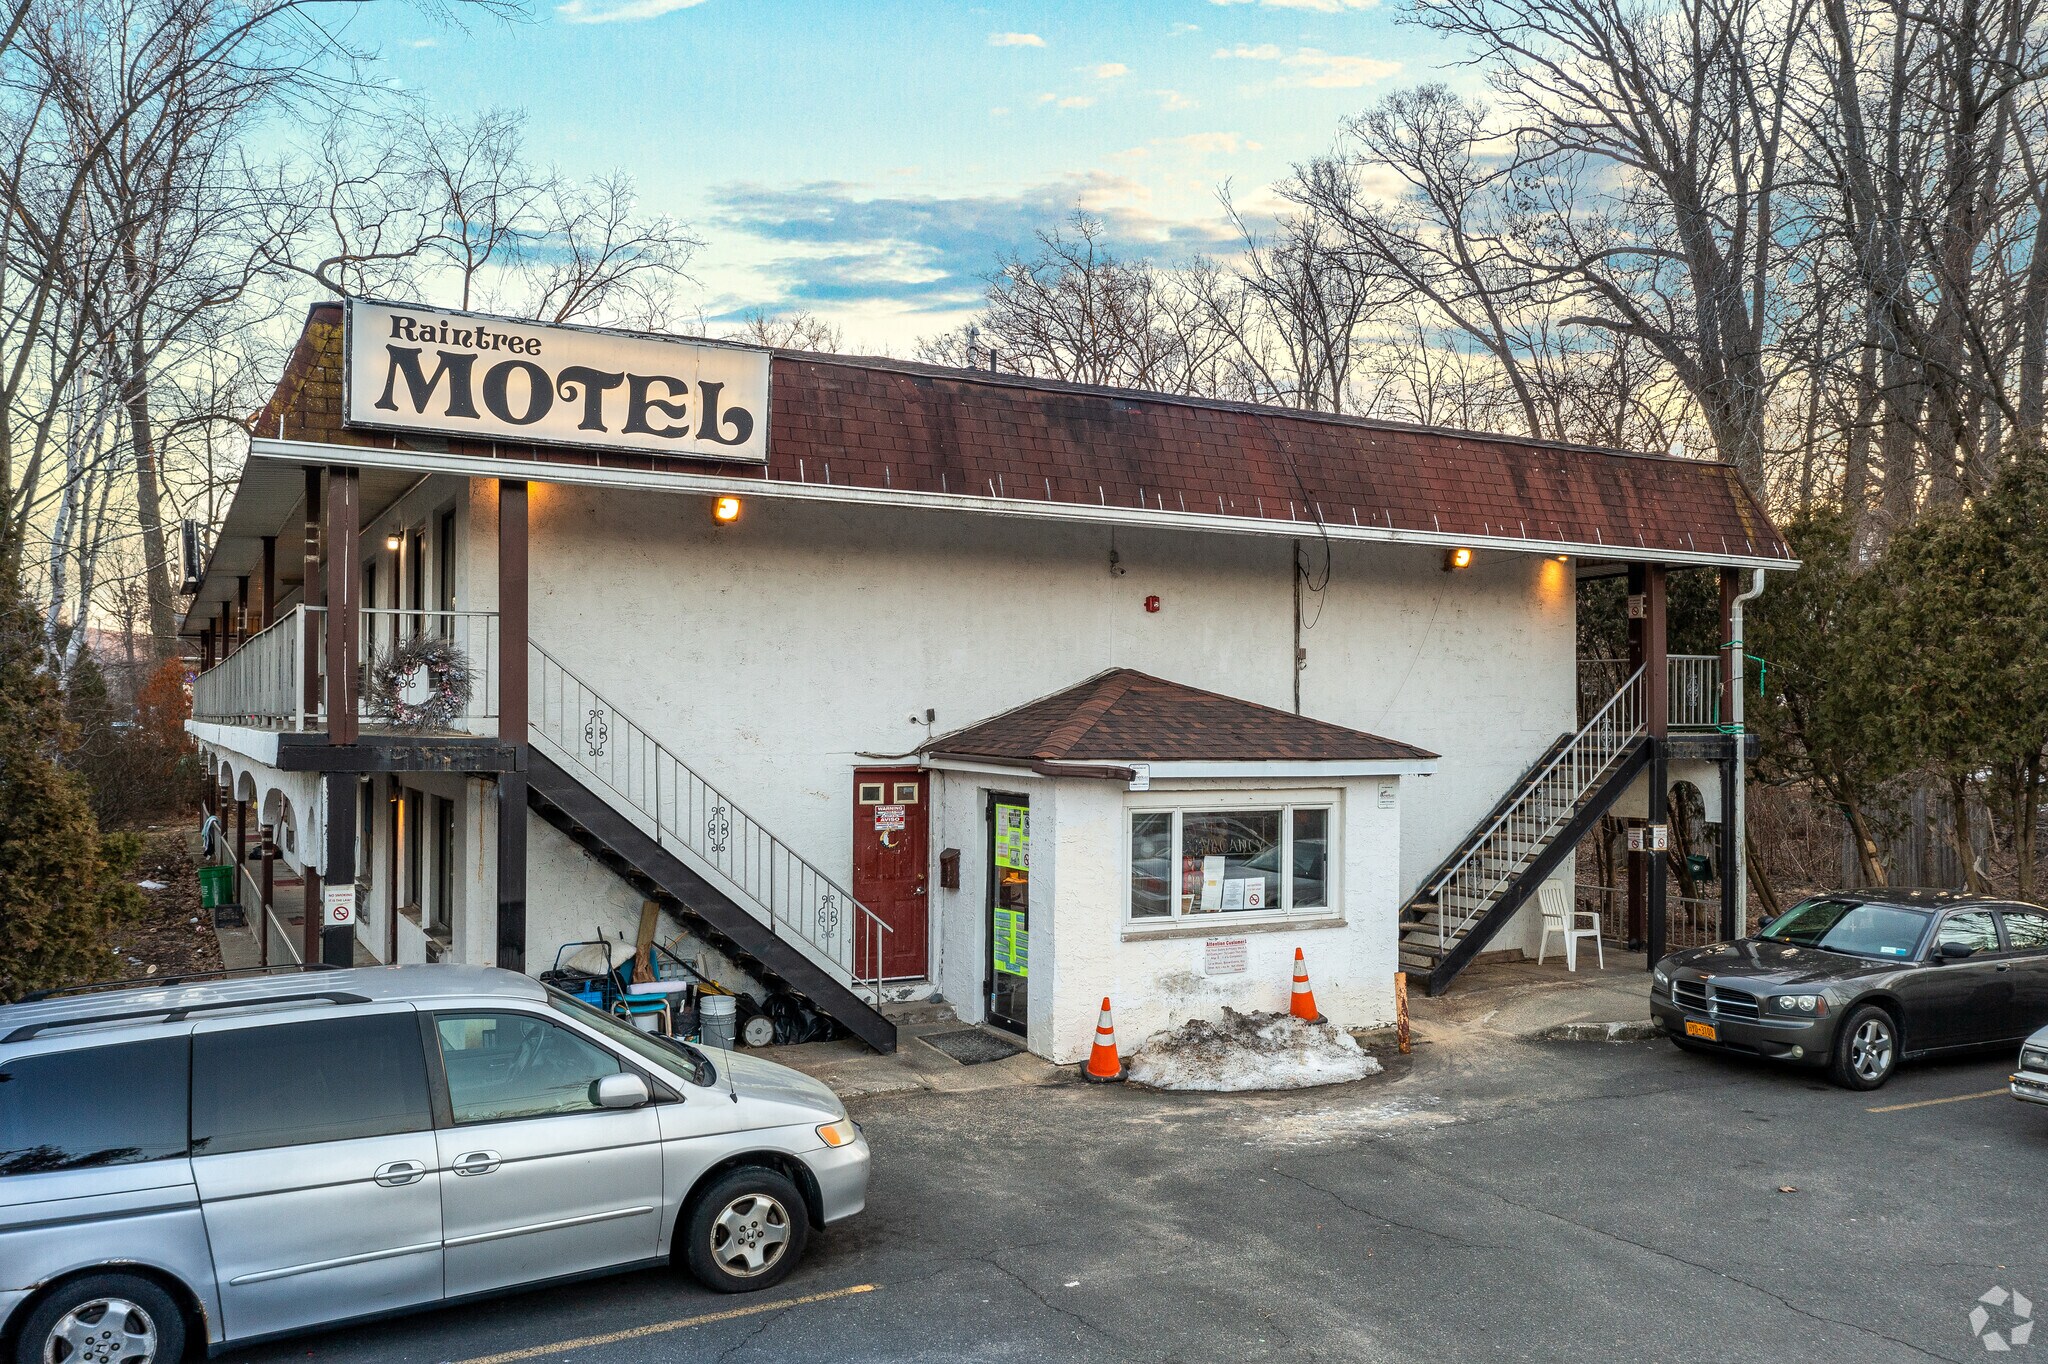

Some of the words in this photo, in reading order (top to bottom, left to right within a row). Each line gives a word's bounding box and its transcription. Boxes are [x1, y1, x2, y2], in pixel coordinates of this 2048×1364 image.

[389, 314, 542, 356] Raintree
[374, 343, 754, 446] MOTEL
[1200, 837, 1263, 853] VACANCY
